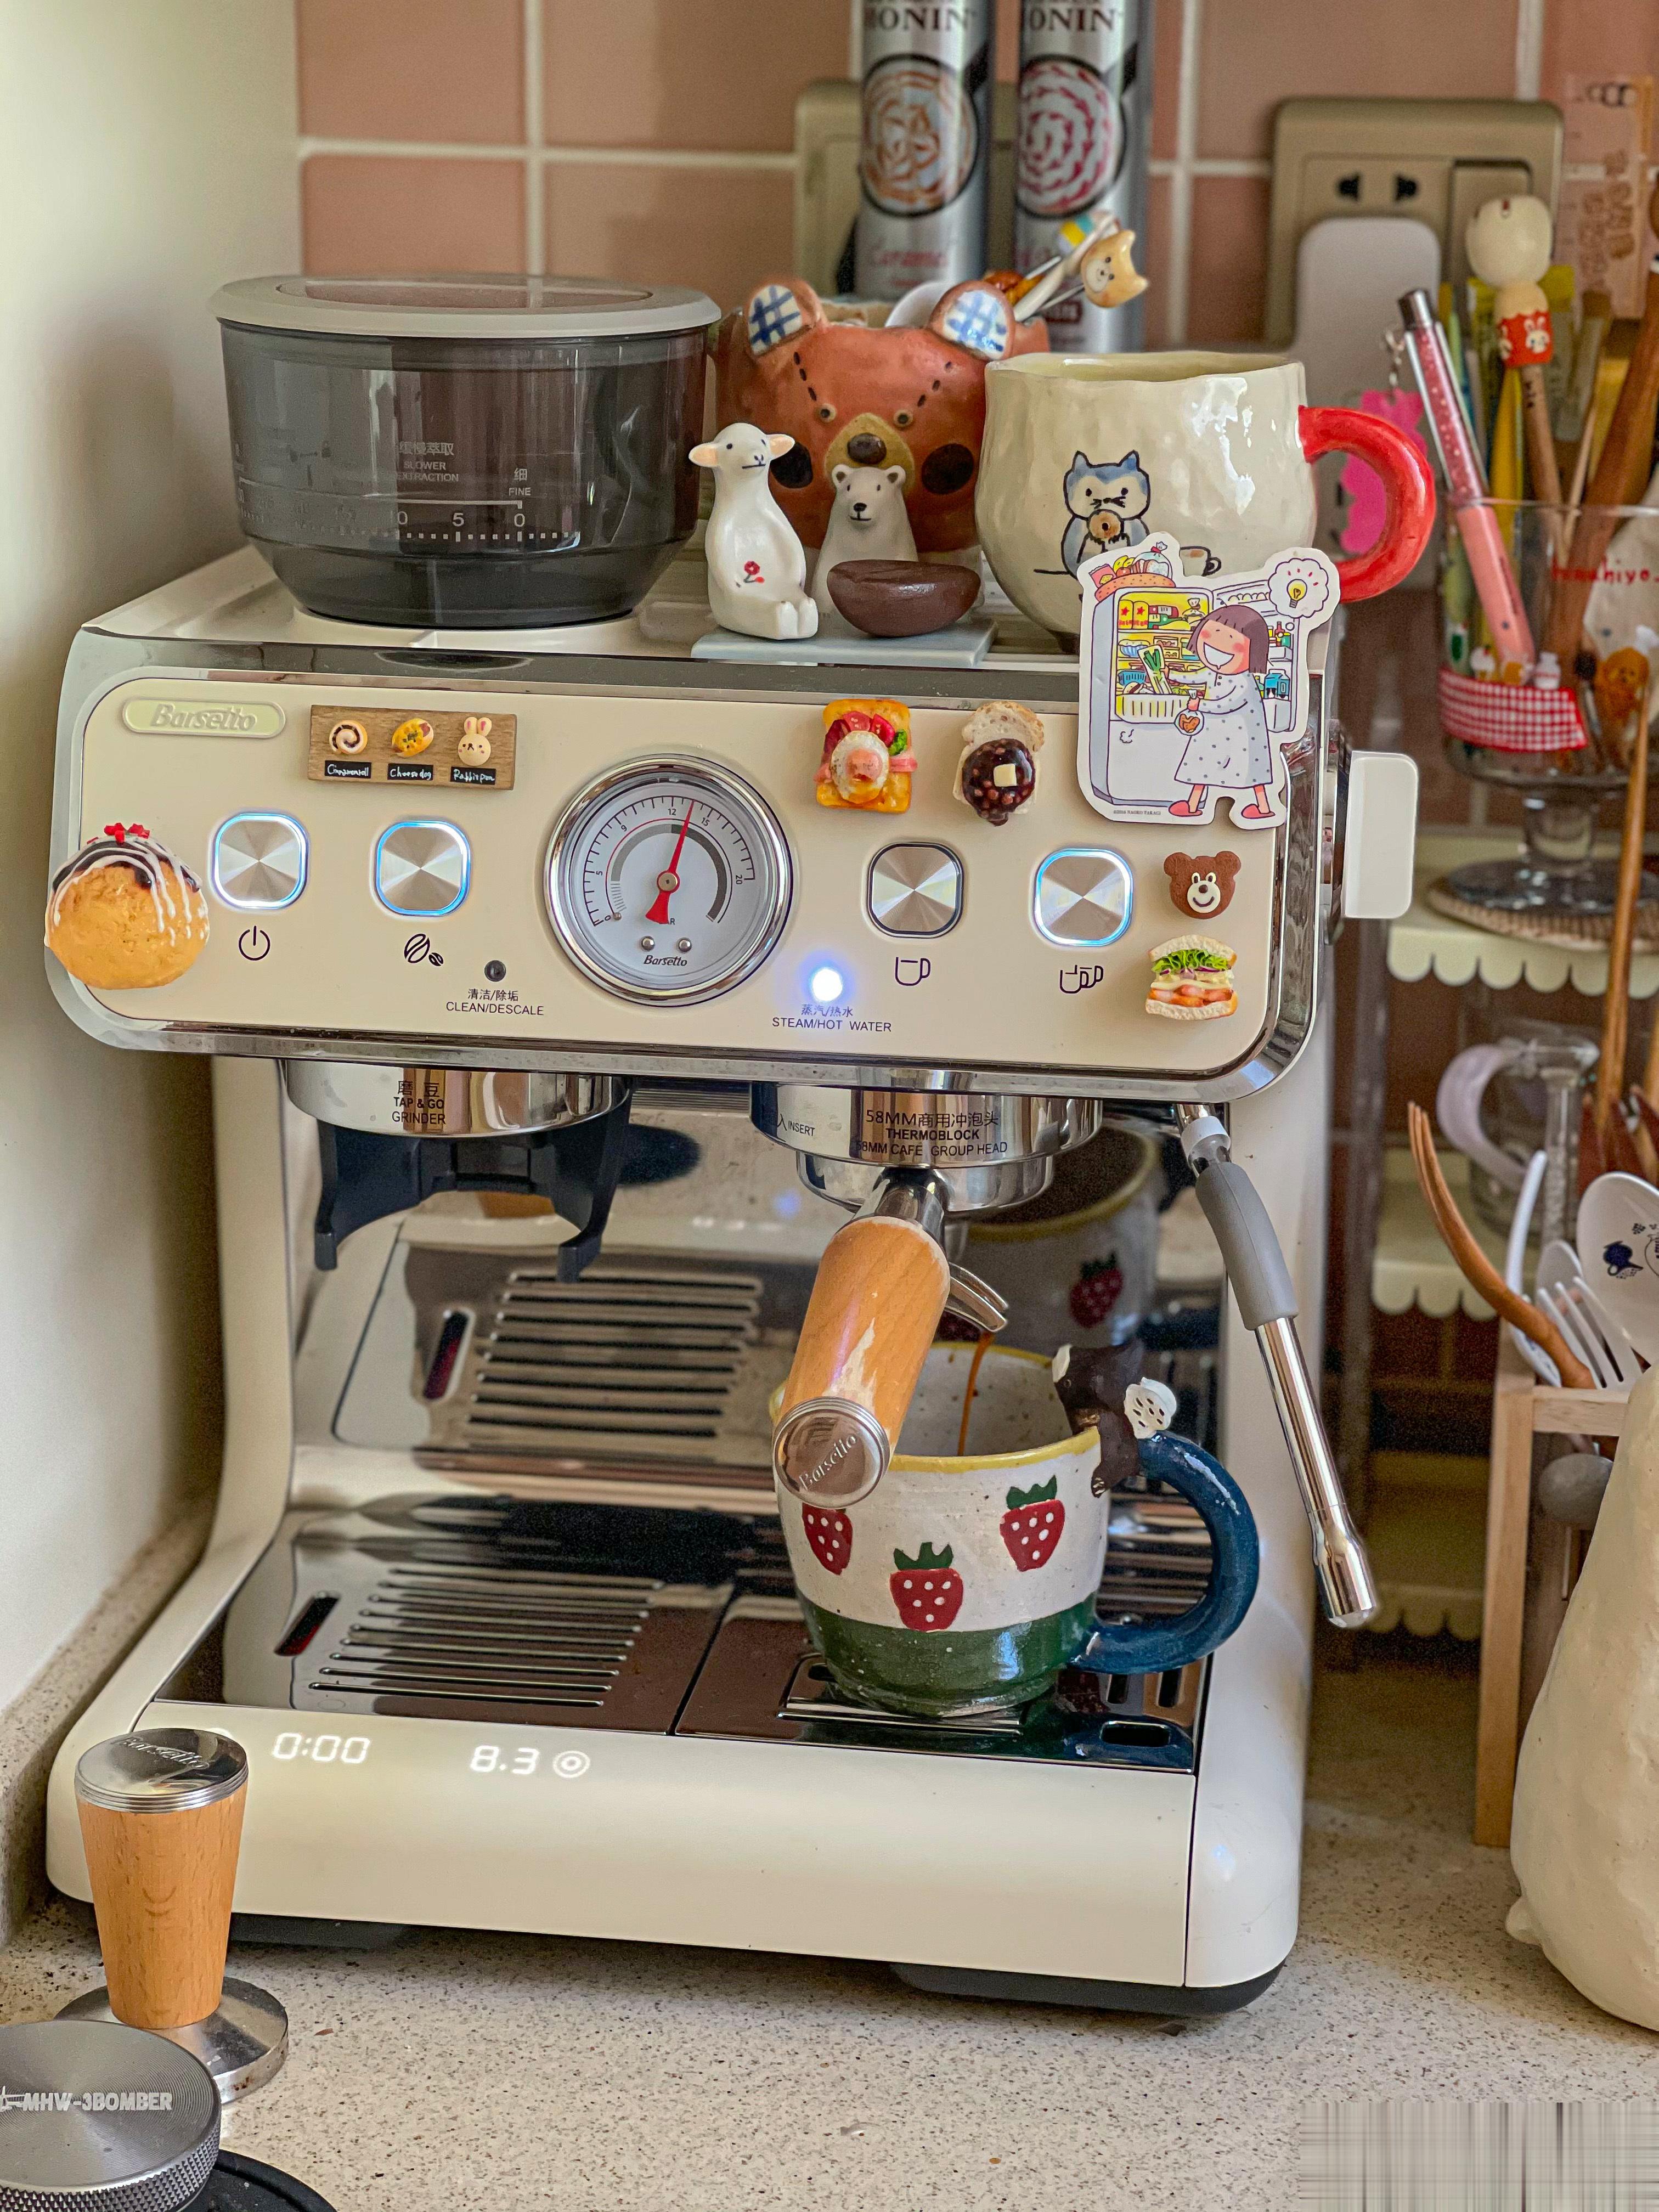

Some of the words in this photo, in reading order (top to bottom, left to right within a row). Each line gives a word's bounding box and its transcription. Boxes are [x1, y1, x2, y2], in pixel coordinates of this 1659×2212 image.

[1029, 8, 1115, 30] ONIN
[404, 461, 446, 470] SLOWER
[398, 472, 459, 482] EXTRACTION
[514, 467, 527, 481] 细
[509, 487, 531, 496] FINE
[452, 512, 464, 527] 5
[514, 514, 525, 527] 0
[150, 703, 257, 731] Barsetto
[668, 808, 676, 816] 12
[701, 817, 710, 827] 15
[735, 874, 743, 885] 20
[644, 955, 688, 967] Barsetto
[467, 988, 518, 1002] 清洁/除垢
[446, 1001, 544, 1015] CLEAN/DESCALE
[801, 1004, 853, 1017] 蒸汽/热水
[772, 1017, 843, 1030] STEAM/HOT
[849, 1021, 892, 1032] WATER
[393, 1096, 413, 1108] TAP
[417, 1098, 424, 1108] &
[428, 1098, 444, 1109] GO
[392, 1111, 445, 1125] GRINDER
[866, 1109, 998, 1128] 58MM商用冲泡头
[788, 1120, 815, 1137] INSERT
[885, 1127, 980, 1141] THERMOBLOCK
[856, 1141, 887, 1154] 58MM
[890, 1143, 923, 1156] CAFE
[931, 1144, 974, 1156] GROUP
[977, 1142, 1007, 1155] HEAD
[272, 1732, 371, 1764] 0:00
[470, 1745, 540, 1775] 8.3
[23, 2092, 173, 2111] MHW-3BOMBER
